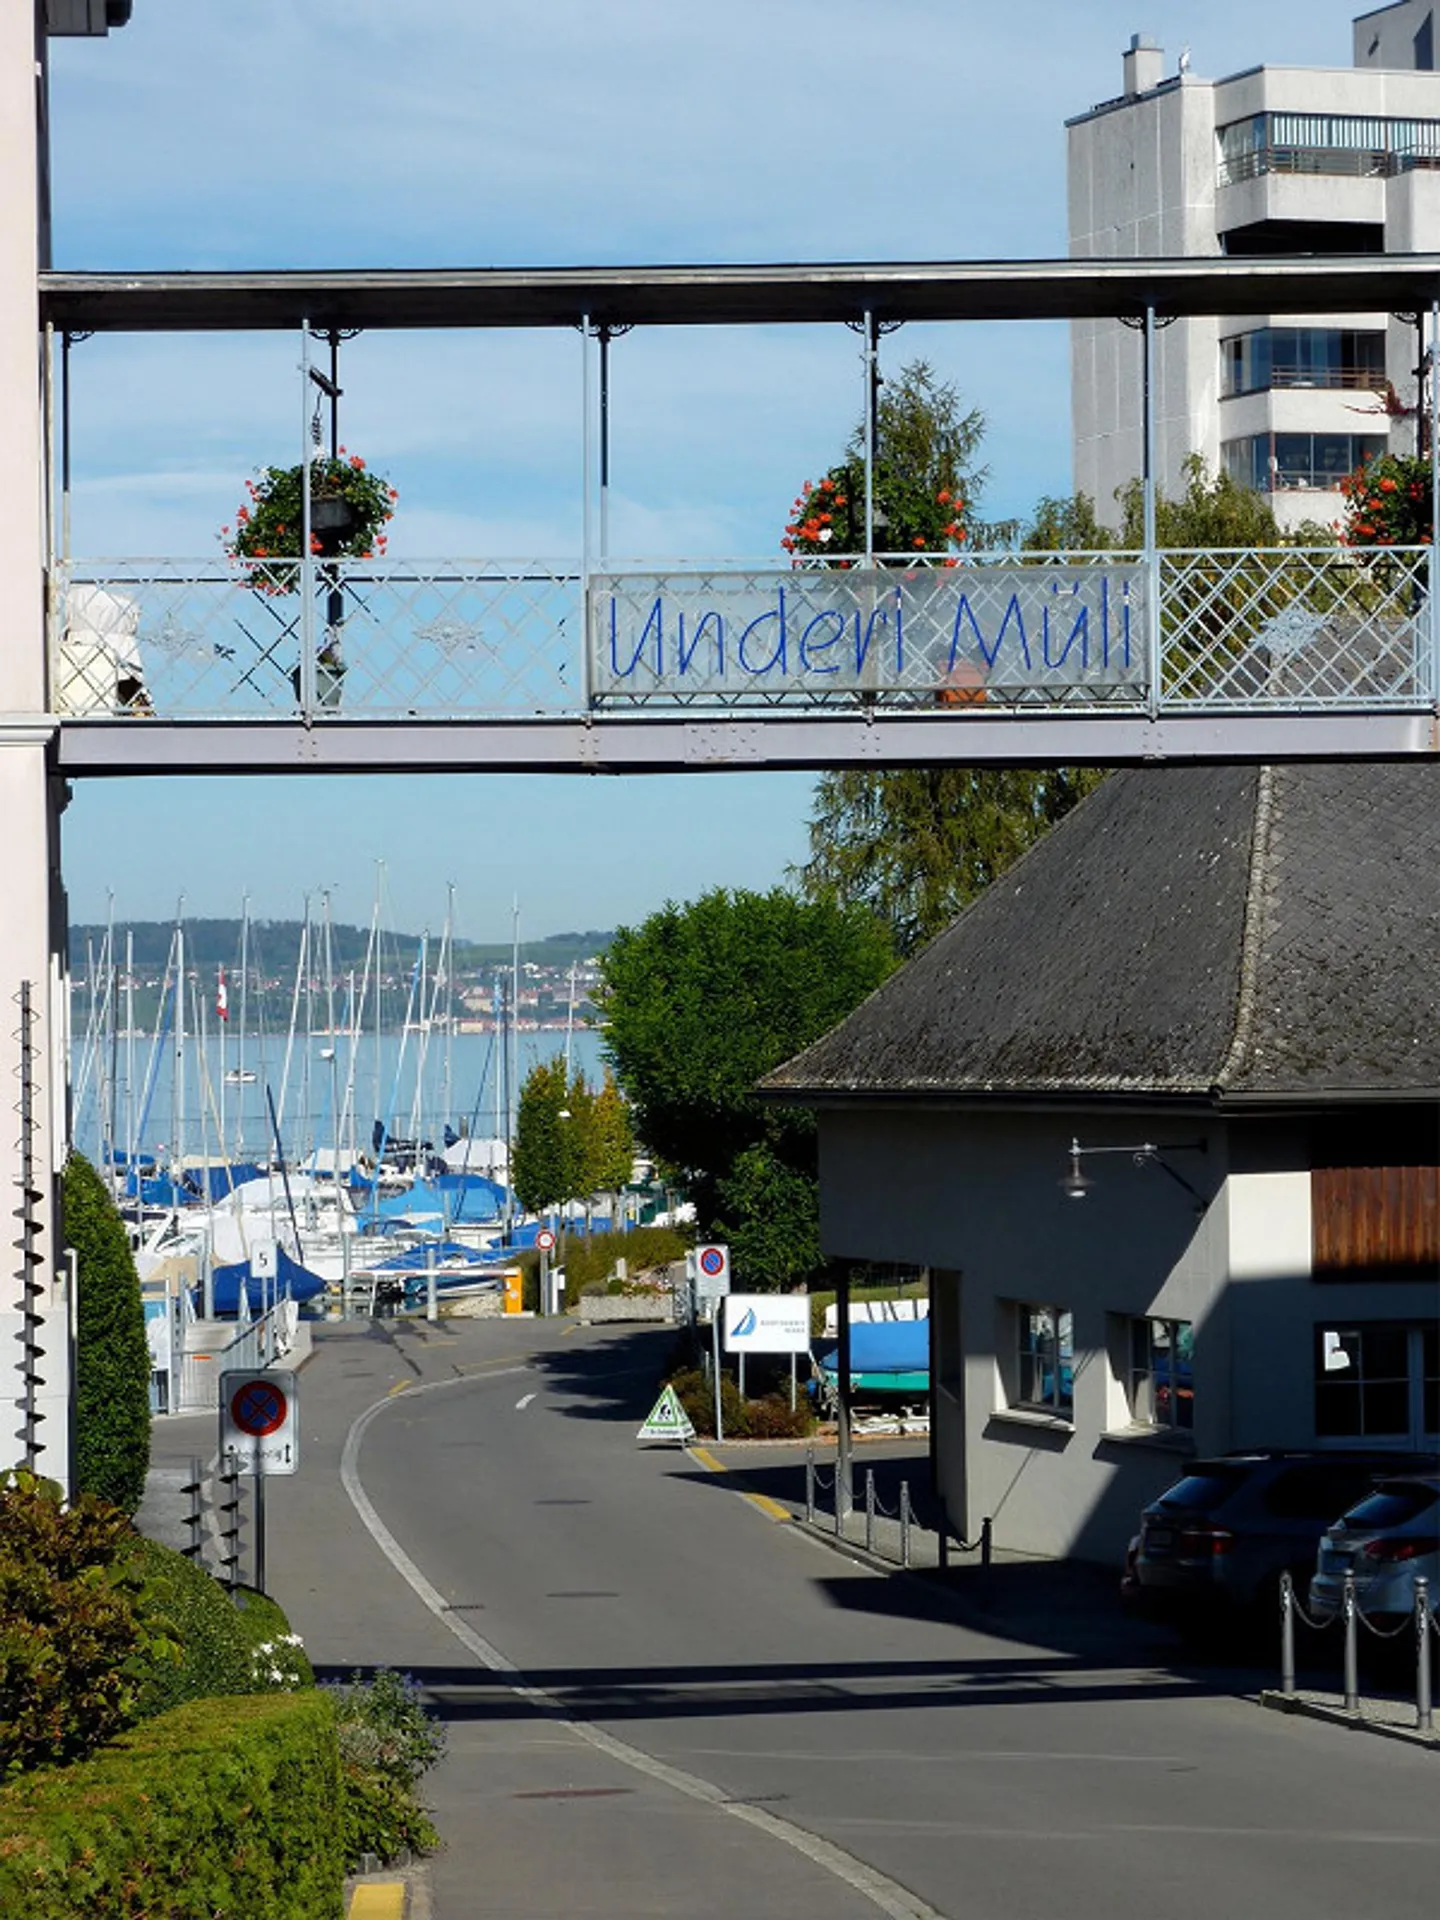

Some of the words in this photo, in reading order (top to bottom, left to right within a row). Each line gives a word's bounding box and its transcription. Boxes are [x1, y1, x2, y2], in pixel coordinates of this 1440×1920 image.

[610, 586, 902, 677] Underi
[946, 576, 1131, 672] Müli
[259, 1252, 268, 1268] 5
